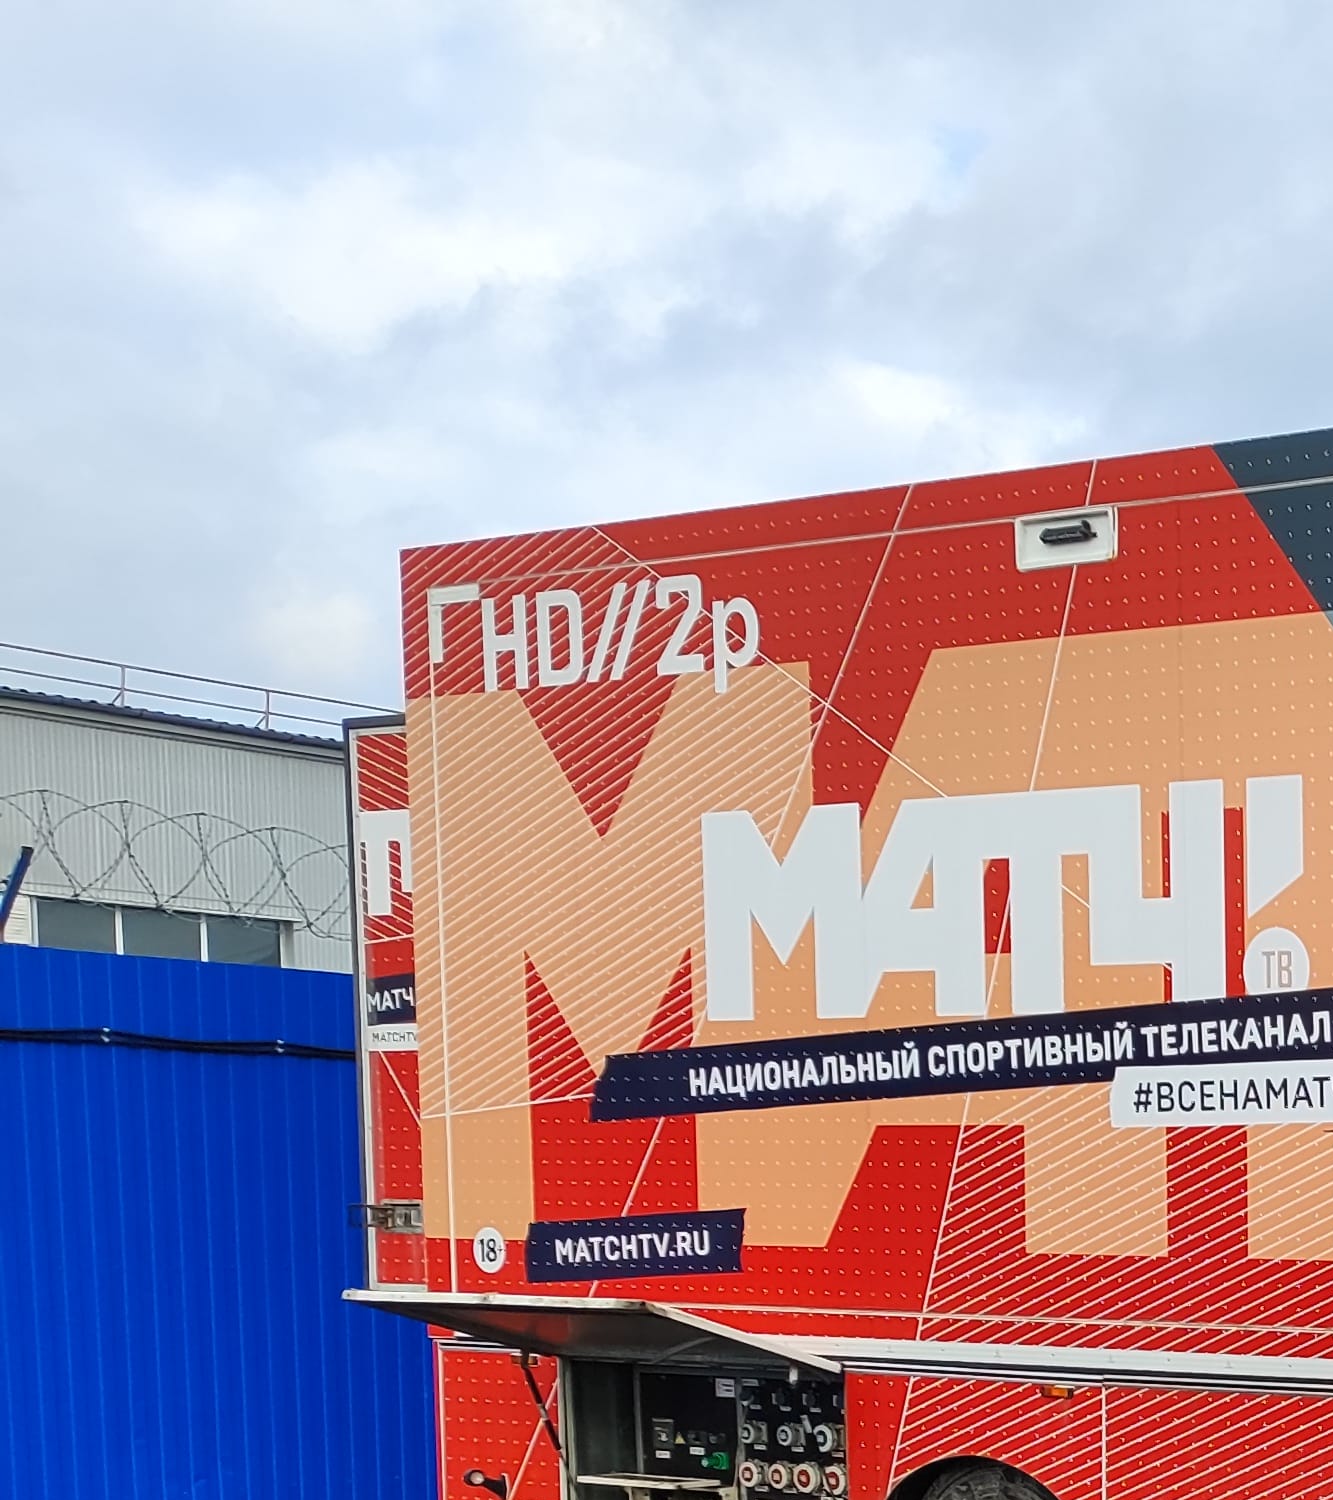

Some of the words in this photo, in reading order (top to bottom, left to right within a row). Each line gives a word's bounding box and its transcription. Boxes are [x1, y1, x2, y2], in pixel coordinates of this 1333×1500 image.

[1261, 949, 1294, 989] ТВ
[688, 1041, 921, 1098] НАЦИОНАЛЬНЫЙ
[927, 1021, 1135, 1078] СПОРТИВНЫЙ
[1140, 1010, 1332, 1058] ТЕЛЕКАНАЛ
[554, 1230, 710, 1265] MATCHTV.RU
